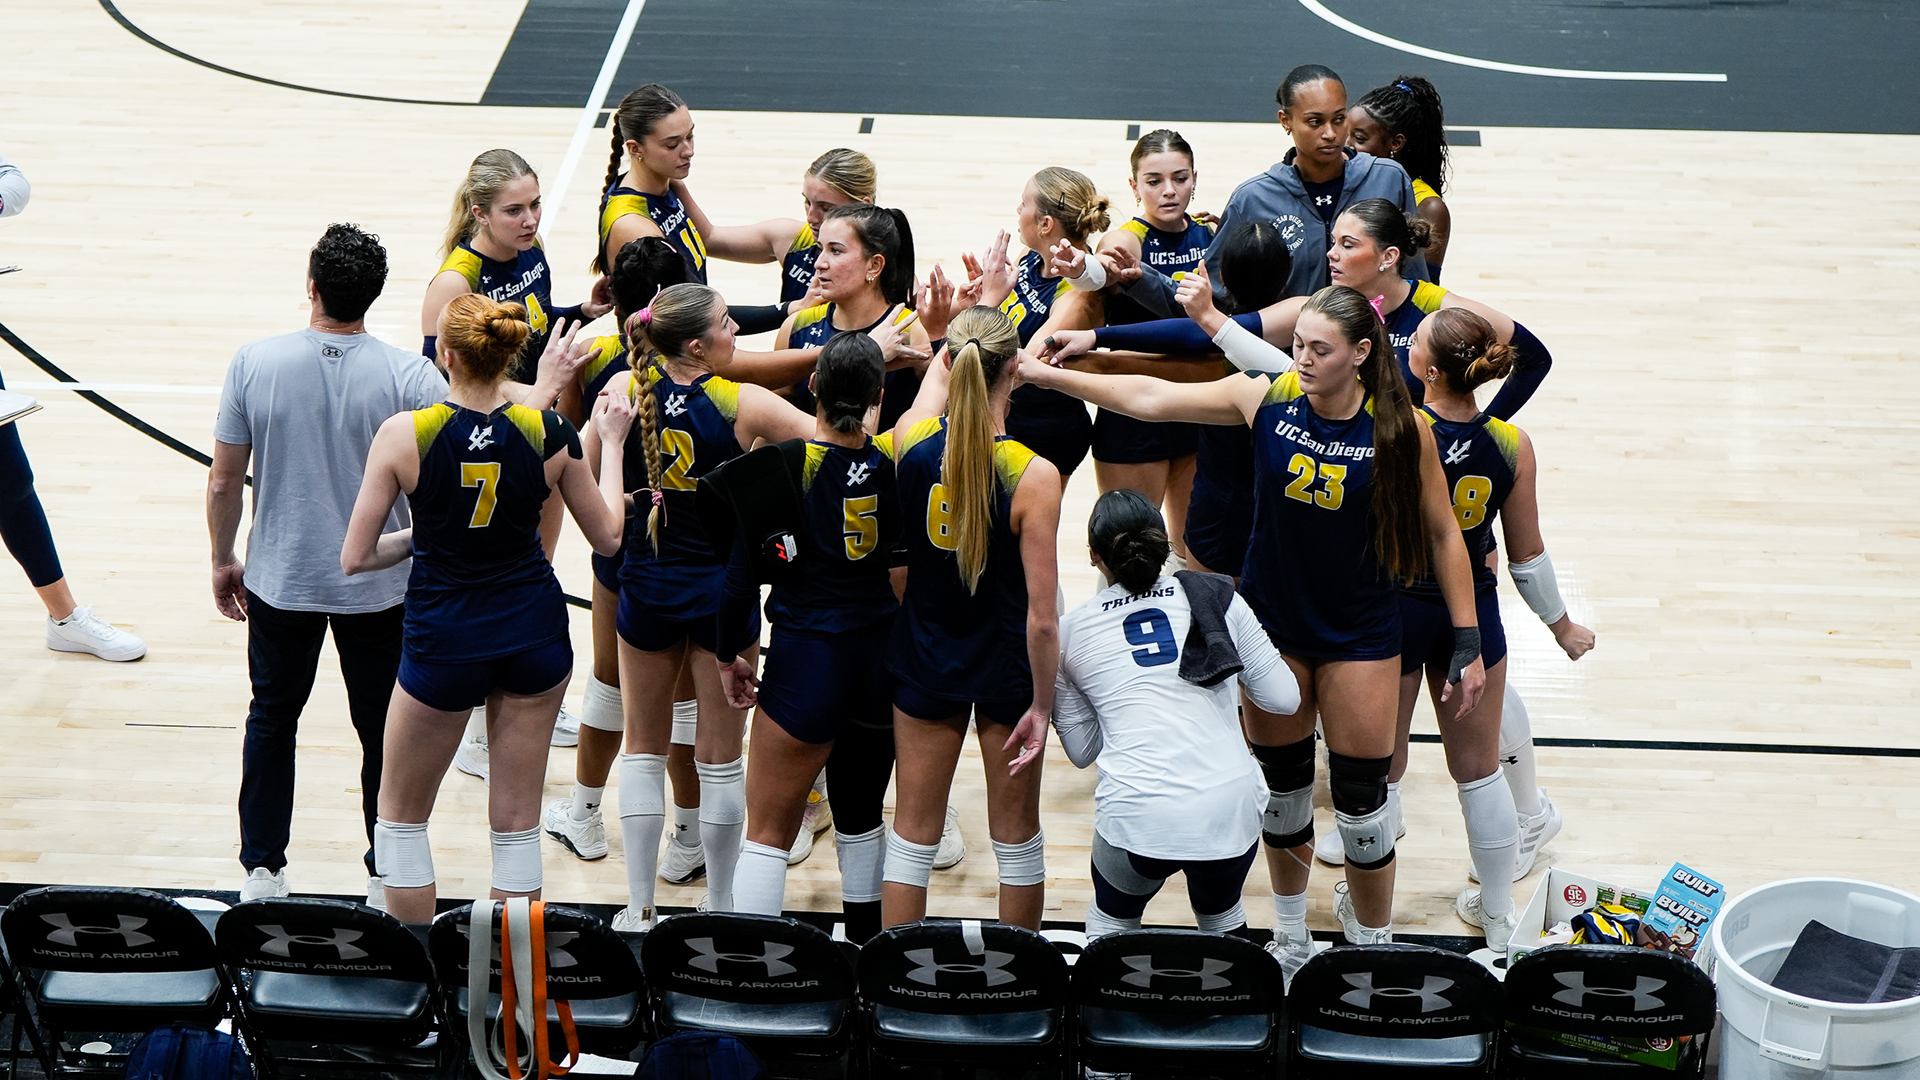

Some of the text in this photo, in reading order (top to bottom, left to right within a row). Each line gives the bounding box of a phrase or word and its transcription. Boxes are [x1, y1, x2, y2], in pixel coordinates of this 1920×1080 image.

[1149, 247, 1209, 265] UC San Die
[487, 286, 506, 301] UC
[522, 262, 545, 288] Dego
[789, 264, 812, 284] UC
[525, 292, 548, 336] 4
[1274, 419, 1376, 461] UC San Diego
[660, 427, 699, 491] 2
[1285, 453, 1347, 510] 23
[460, 462, 501, 528] 7
[1452, 474, 1492, 530] 8
[843, 494, 878, 561] 5
[1102, 586, 1174, 611] TRITONS
[1122, 608, 1178, 668] 9
[1672, 868, 1719, 896] BUILT
[1652, 907, 1678, 923] PUFF
[1656, 894, 1709, 925] BUILT
[33, 948, 179, 959] UNDER ARMOUR
[245, 958, 392, 971] UNDER ARMOUR
[458, 964, 602, 983] UDE MOUR
[671, 972, 819, 988] UNDER ARMOUR
[889, 985, 1038, 1000] UNDER ARMOUR
[1100, 988, 1163, 1000] UNDER
[1319, 1007, 1470, 1025] UNDER ARMOUR
[1531, 1005, 1684, 1024] UNDER ARMOUR
[1561, 1033, 1577, 1041] KETTLE
[1578, 1036, 1591, 1045] STYLE
[1592, 1040, 1607, 1049] POTATO
[1607, 1044, 1619, 1052] CHIPS
